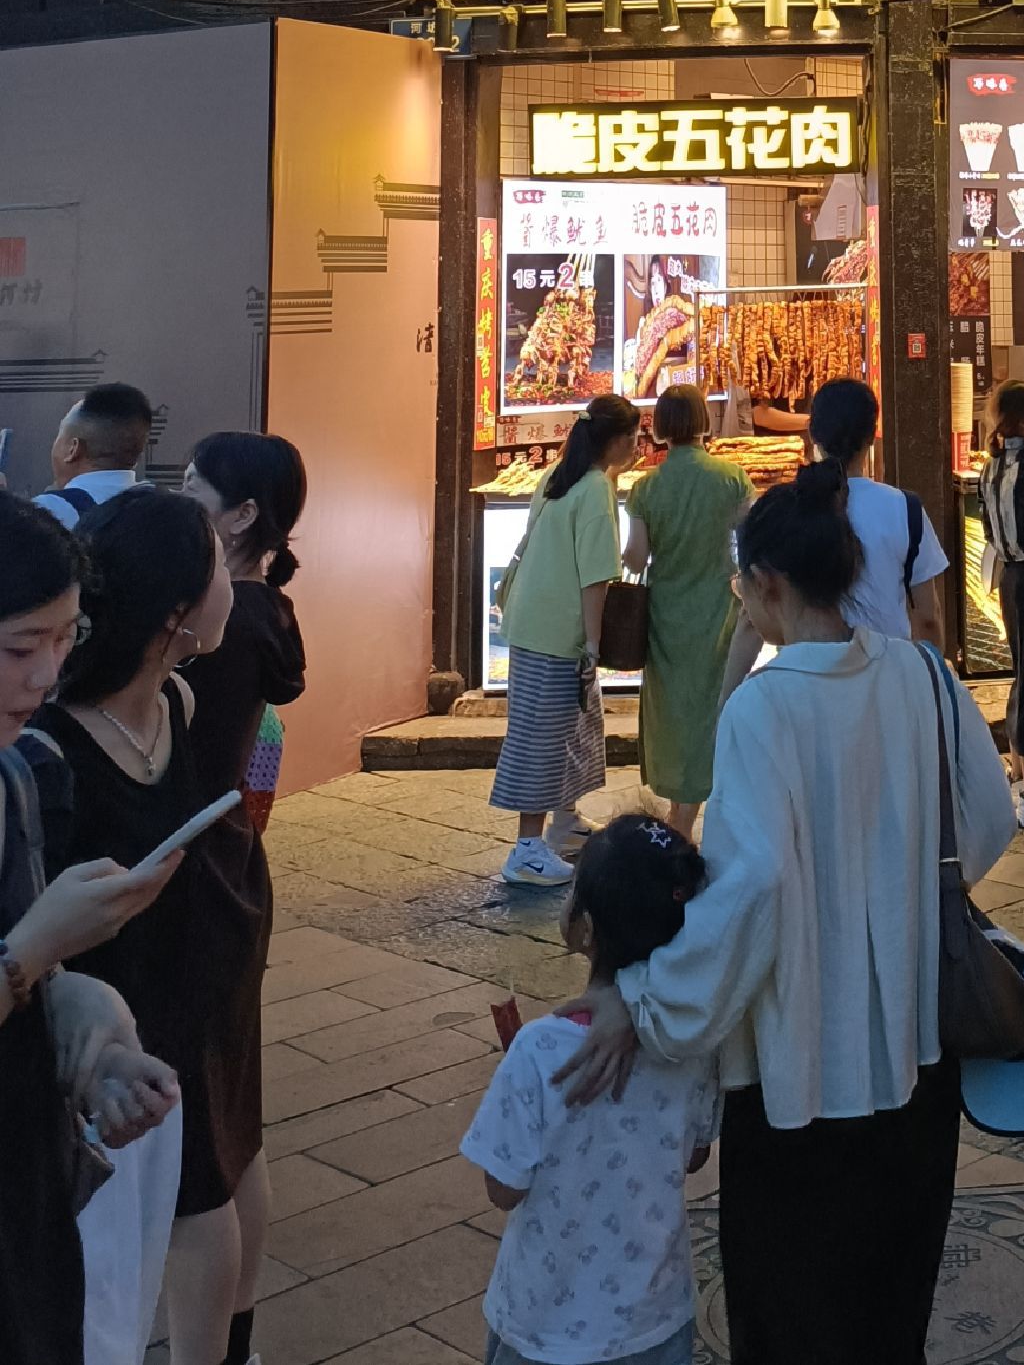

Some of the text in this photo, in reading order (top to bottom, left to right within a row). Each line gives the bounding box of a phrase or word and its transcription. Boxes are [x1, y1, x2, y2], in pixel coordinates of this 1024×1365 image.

[532, 105, 853, 175] 脆皮五花肉
[632, 201, 718, 236] 脆皮五花肉
